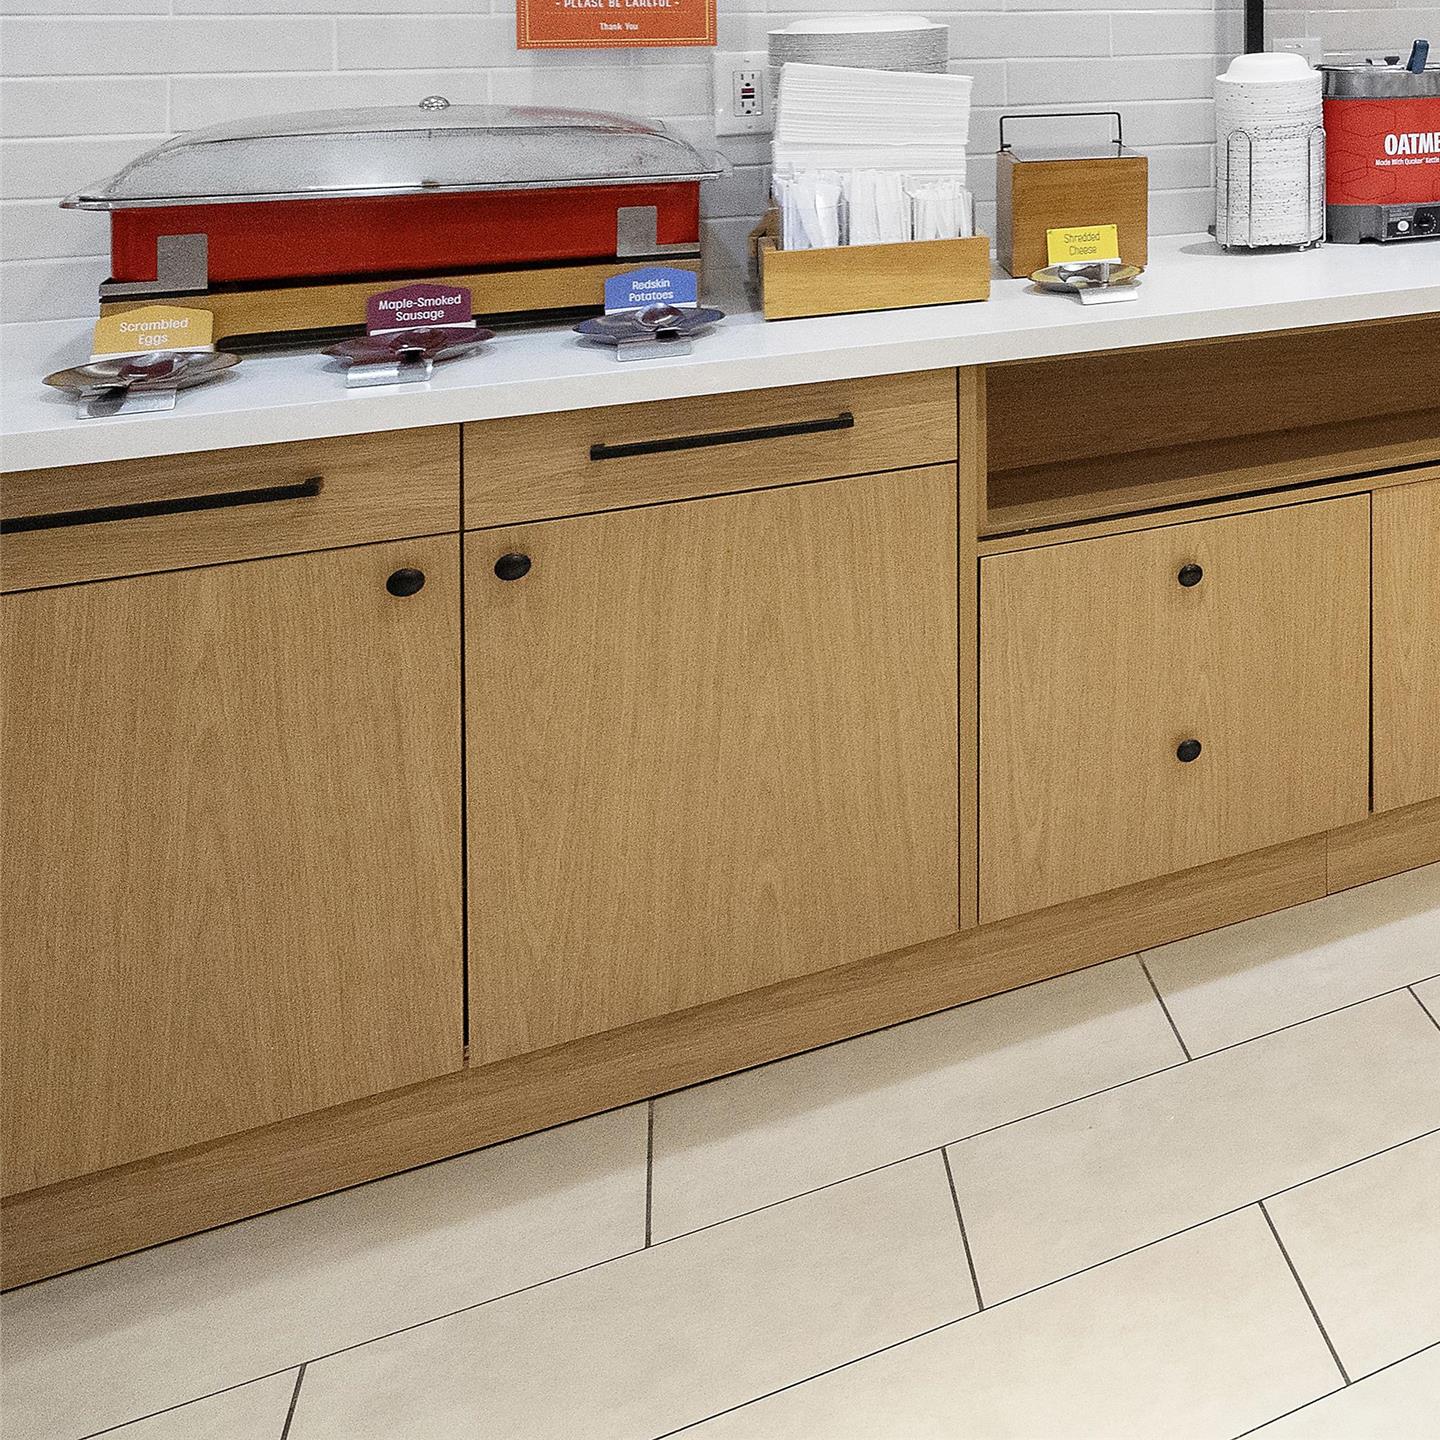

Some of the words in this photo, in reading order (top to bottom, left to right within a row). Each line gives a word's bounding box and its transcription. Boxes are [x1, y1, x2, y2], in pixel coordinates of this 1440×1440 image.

[599, 22, 622, 31] Thank
[625, 22, 639, 31] You
[1064, 232, 1100, 244] Shredded
[1068, 245, 1097, 256] Cheese
[632, 278, 670, 290] Redskin
[628, 290, 674, 302] Potatoes
[378, 294, 462, 311] Maple-Smoked
[395, 310, 445, 321] Sausage
[120, 317, 189, 333] Scrambled
[138, 334, 168, 347] Eggs
